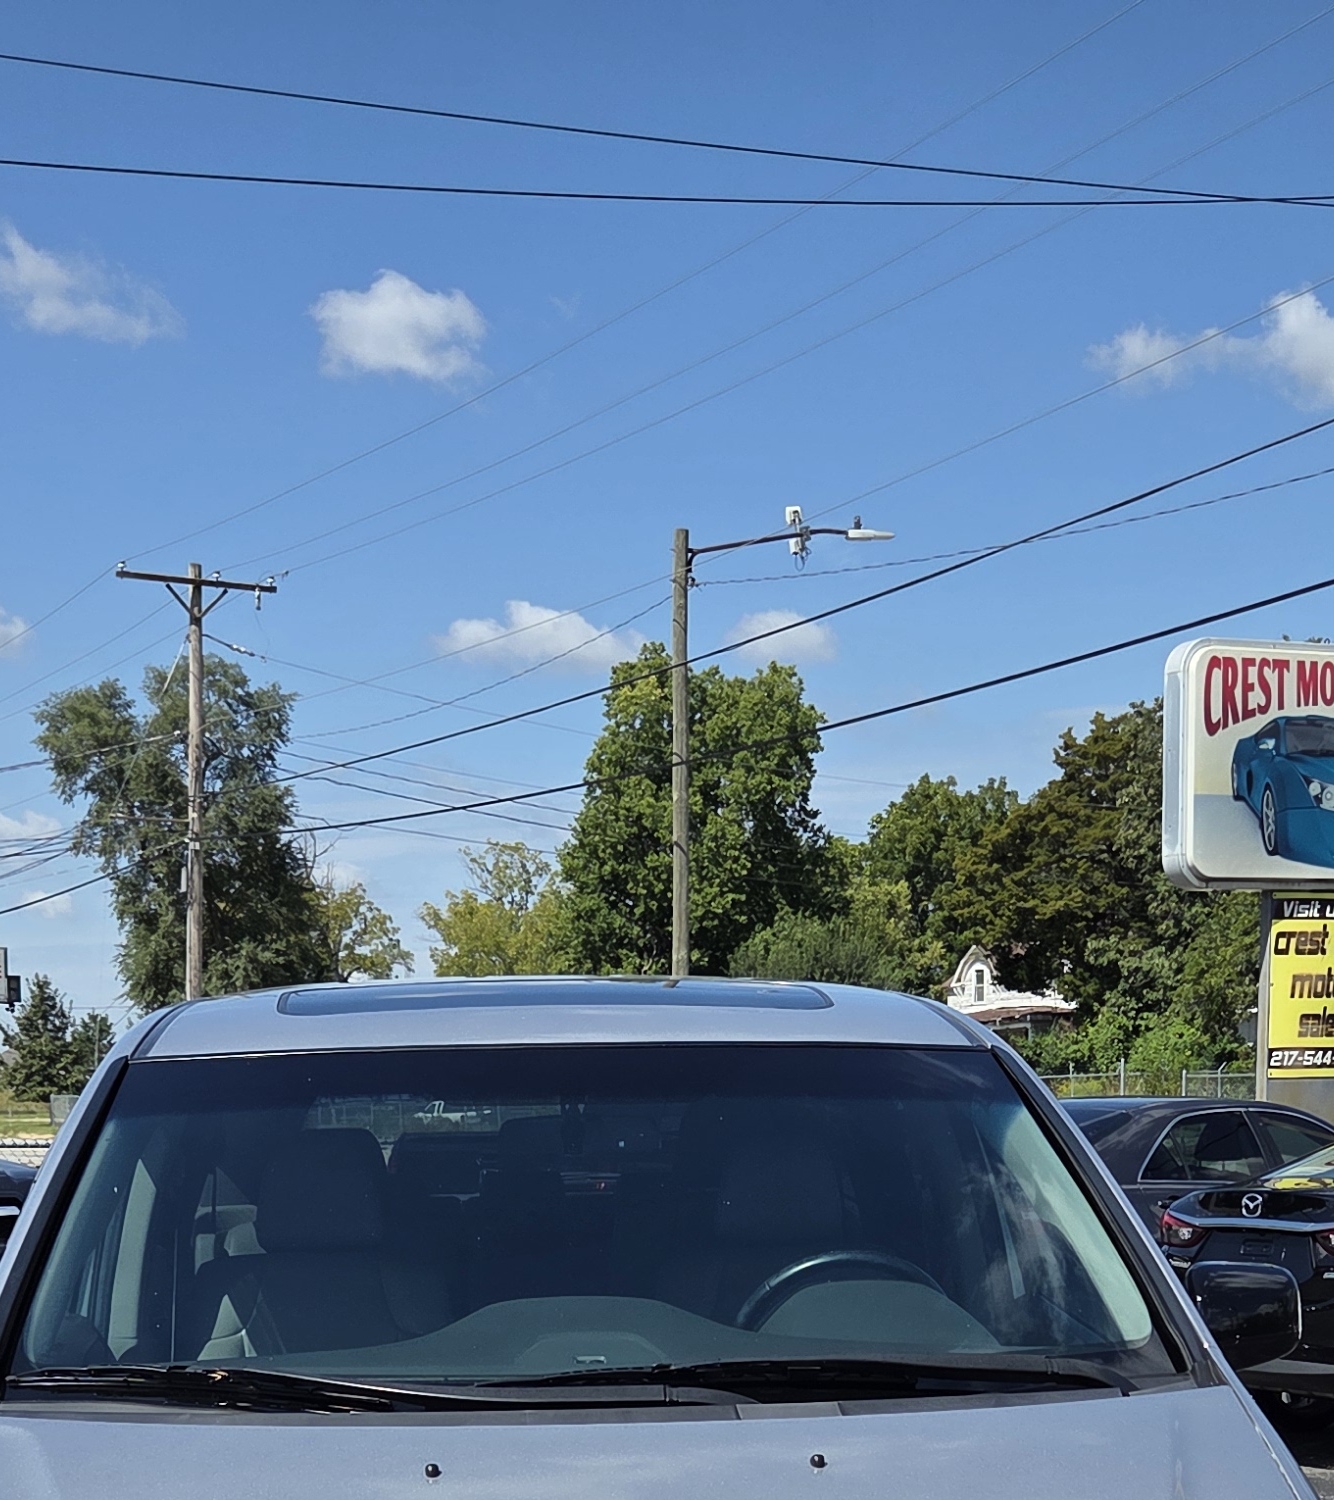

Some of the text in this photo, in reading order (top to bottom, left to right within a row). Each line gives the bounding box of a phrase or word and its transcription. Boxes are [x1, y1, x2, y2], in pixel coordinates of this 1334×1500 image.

[1203, 655, 1290, 737] CREST
[1283, 901, 1319, 918] Visit
[1274, 924, 1329, 955] crest
